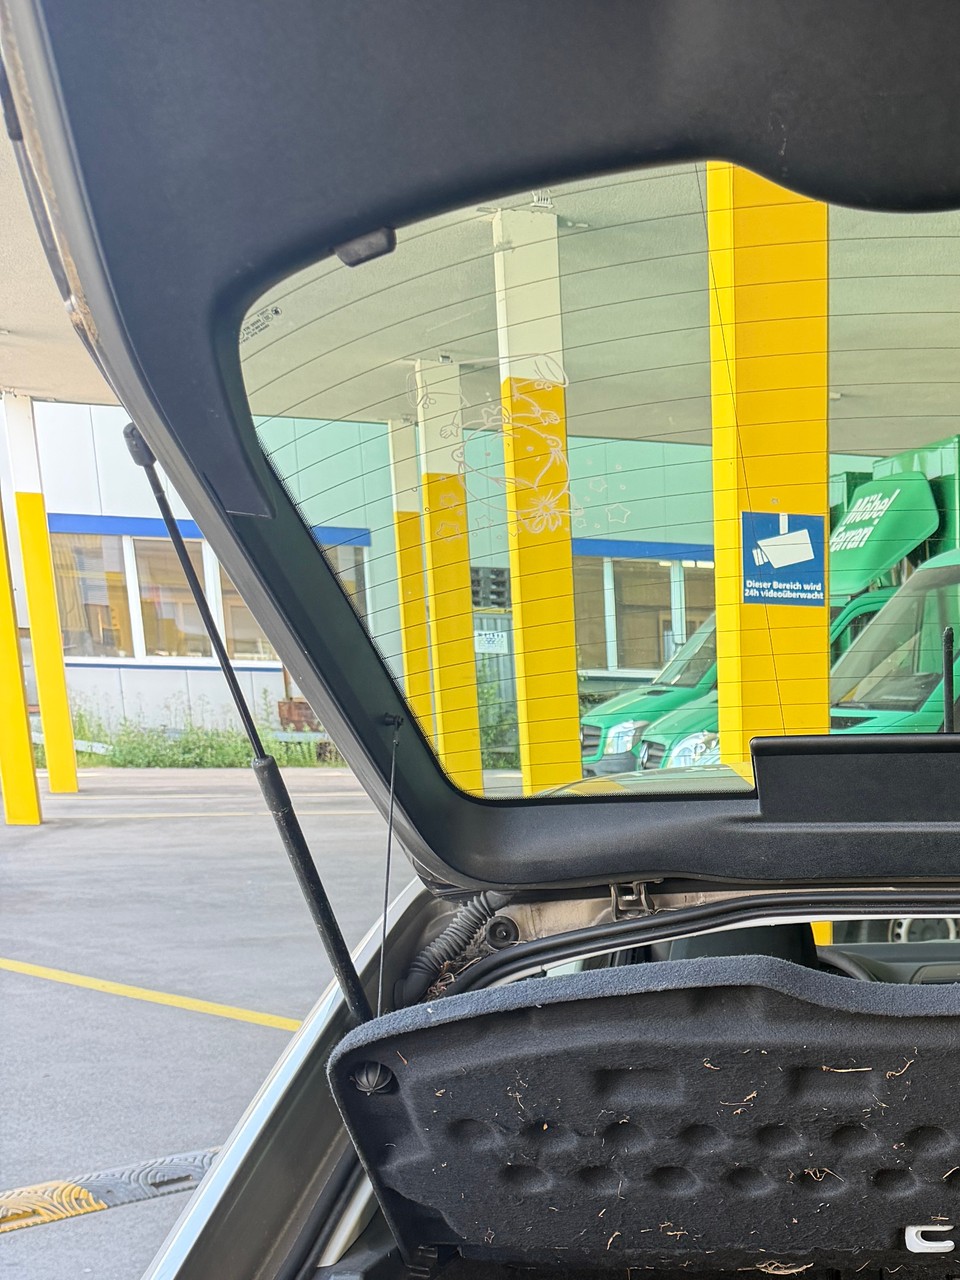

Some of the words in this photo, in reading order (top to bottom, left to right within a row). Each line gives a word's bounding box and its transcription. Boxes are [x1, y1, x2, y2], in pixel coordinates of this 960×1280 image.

[745, 580, 771, 589] Dieser
[772, 581, 802, 591] Bereich
[803, 583, 822, 591] wird
[744, 589, 759, 597] 24h
[760, 589, 824, 600] videoüberwacht
